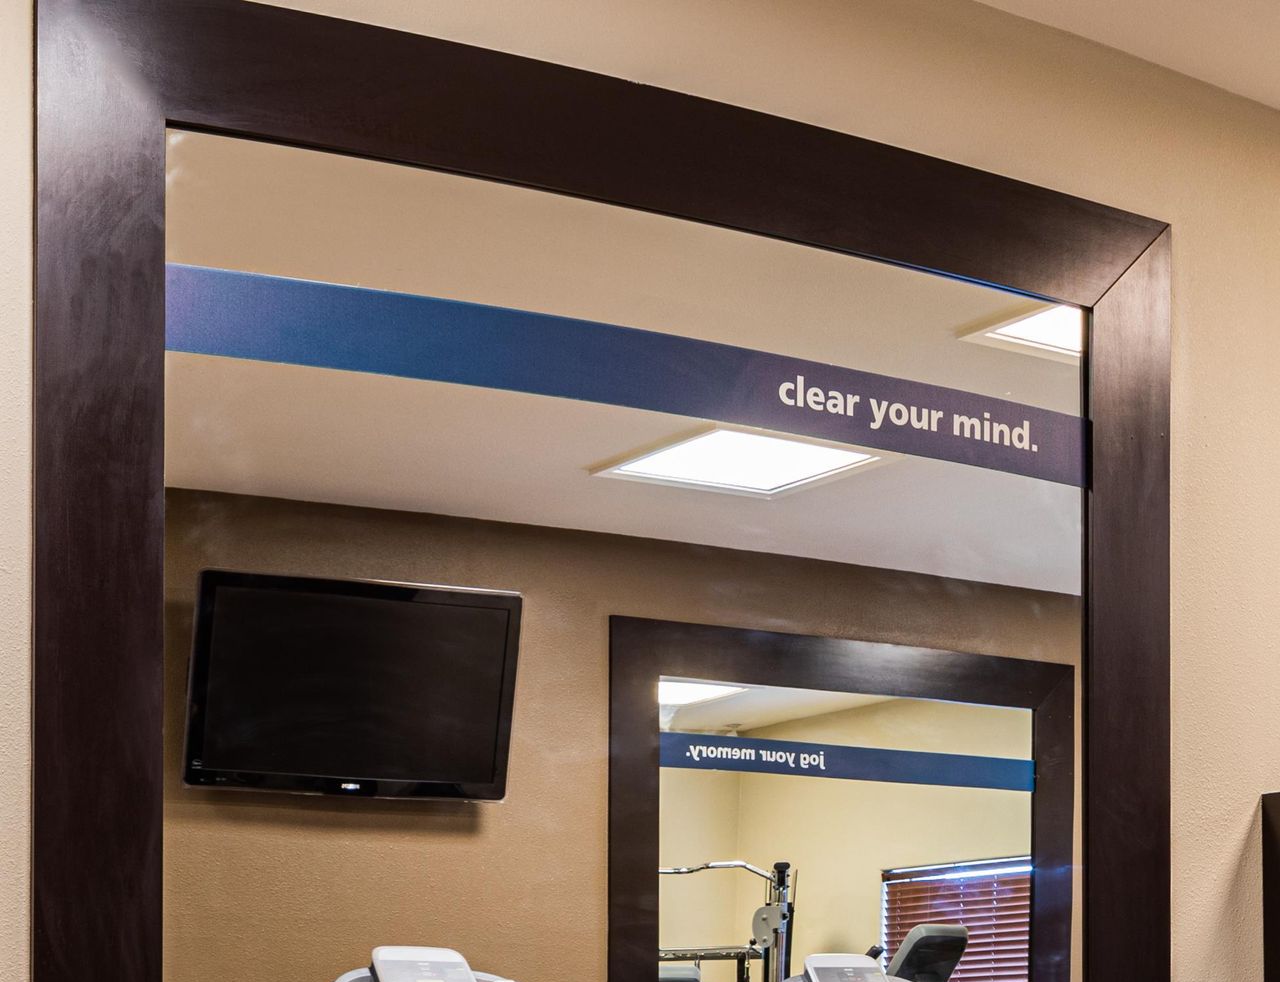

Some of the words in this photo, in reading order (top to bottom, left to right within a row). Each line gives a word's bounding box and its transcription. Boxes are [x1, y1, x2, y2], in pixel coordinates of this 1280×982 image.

[778, 375, 860, 417] clear
[869, 397, 943, 432] your
[953, 412, 1038, 452] mind.
